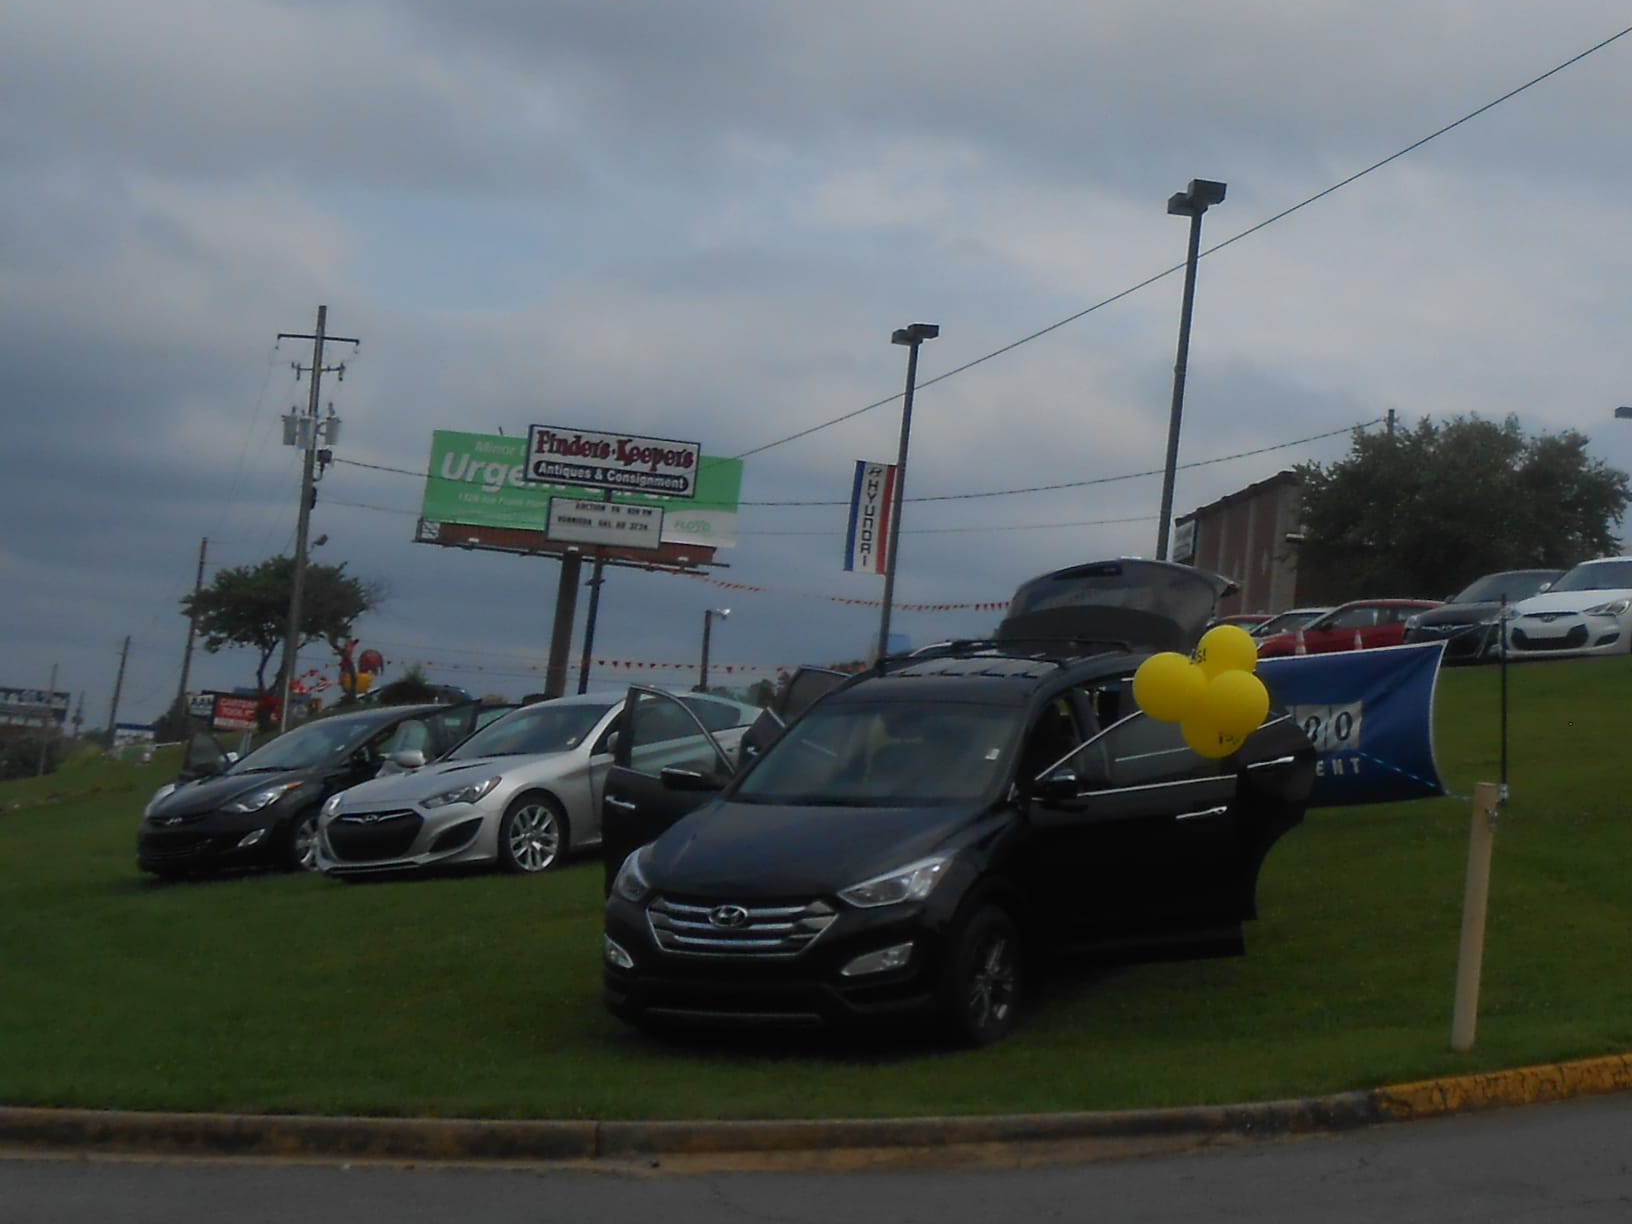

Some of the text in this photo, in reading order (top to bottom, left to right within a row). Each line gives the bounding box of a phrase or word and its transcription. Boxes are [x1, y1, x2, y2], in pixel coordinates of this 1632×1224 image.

[538, 462, 685, 490] Antiques & Consignment
[860, 479, 879, 567] HYUNDAI
